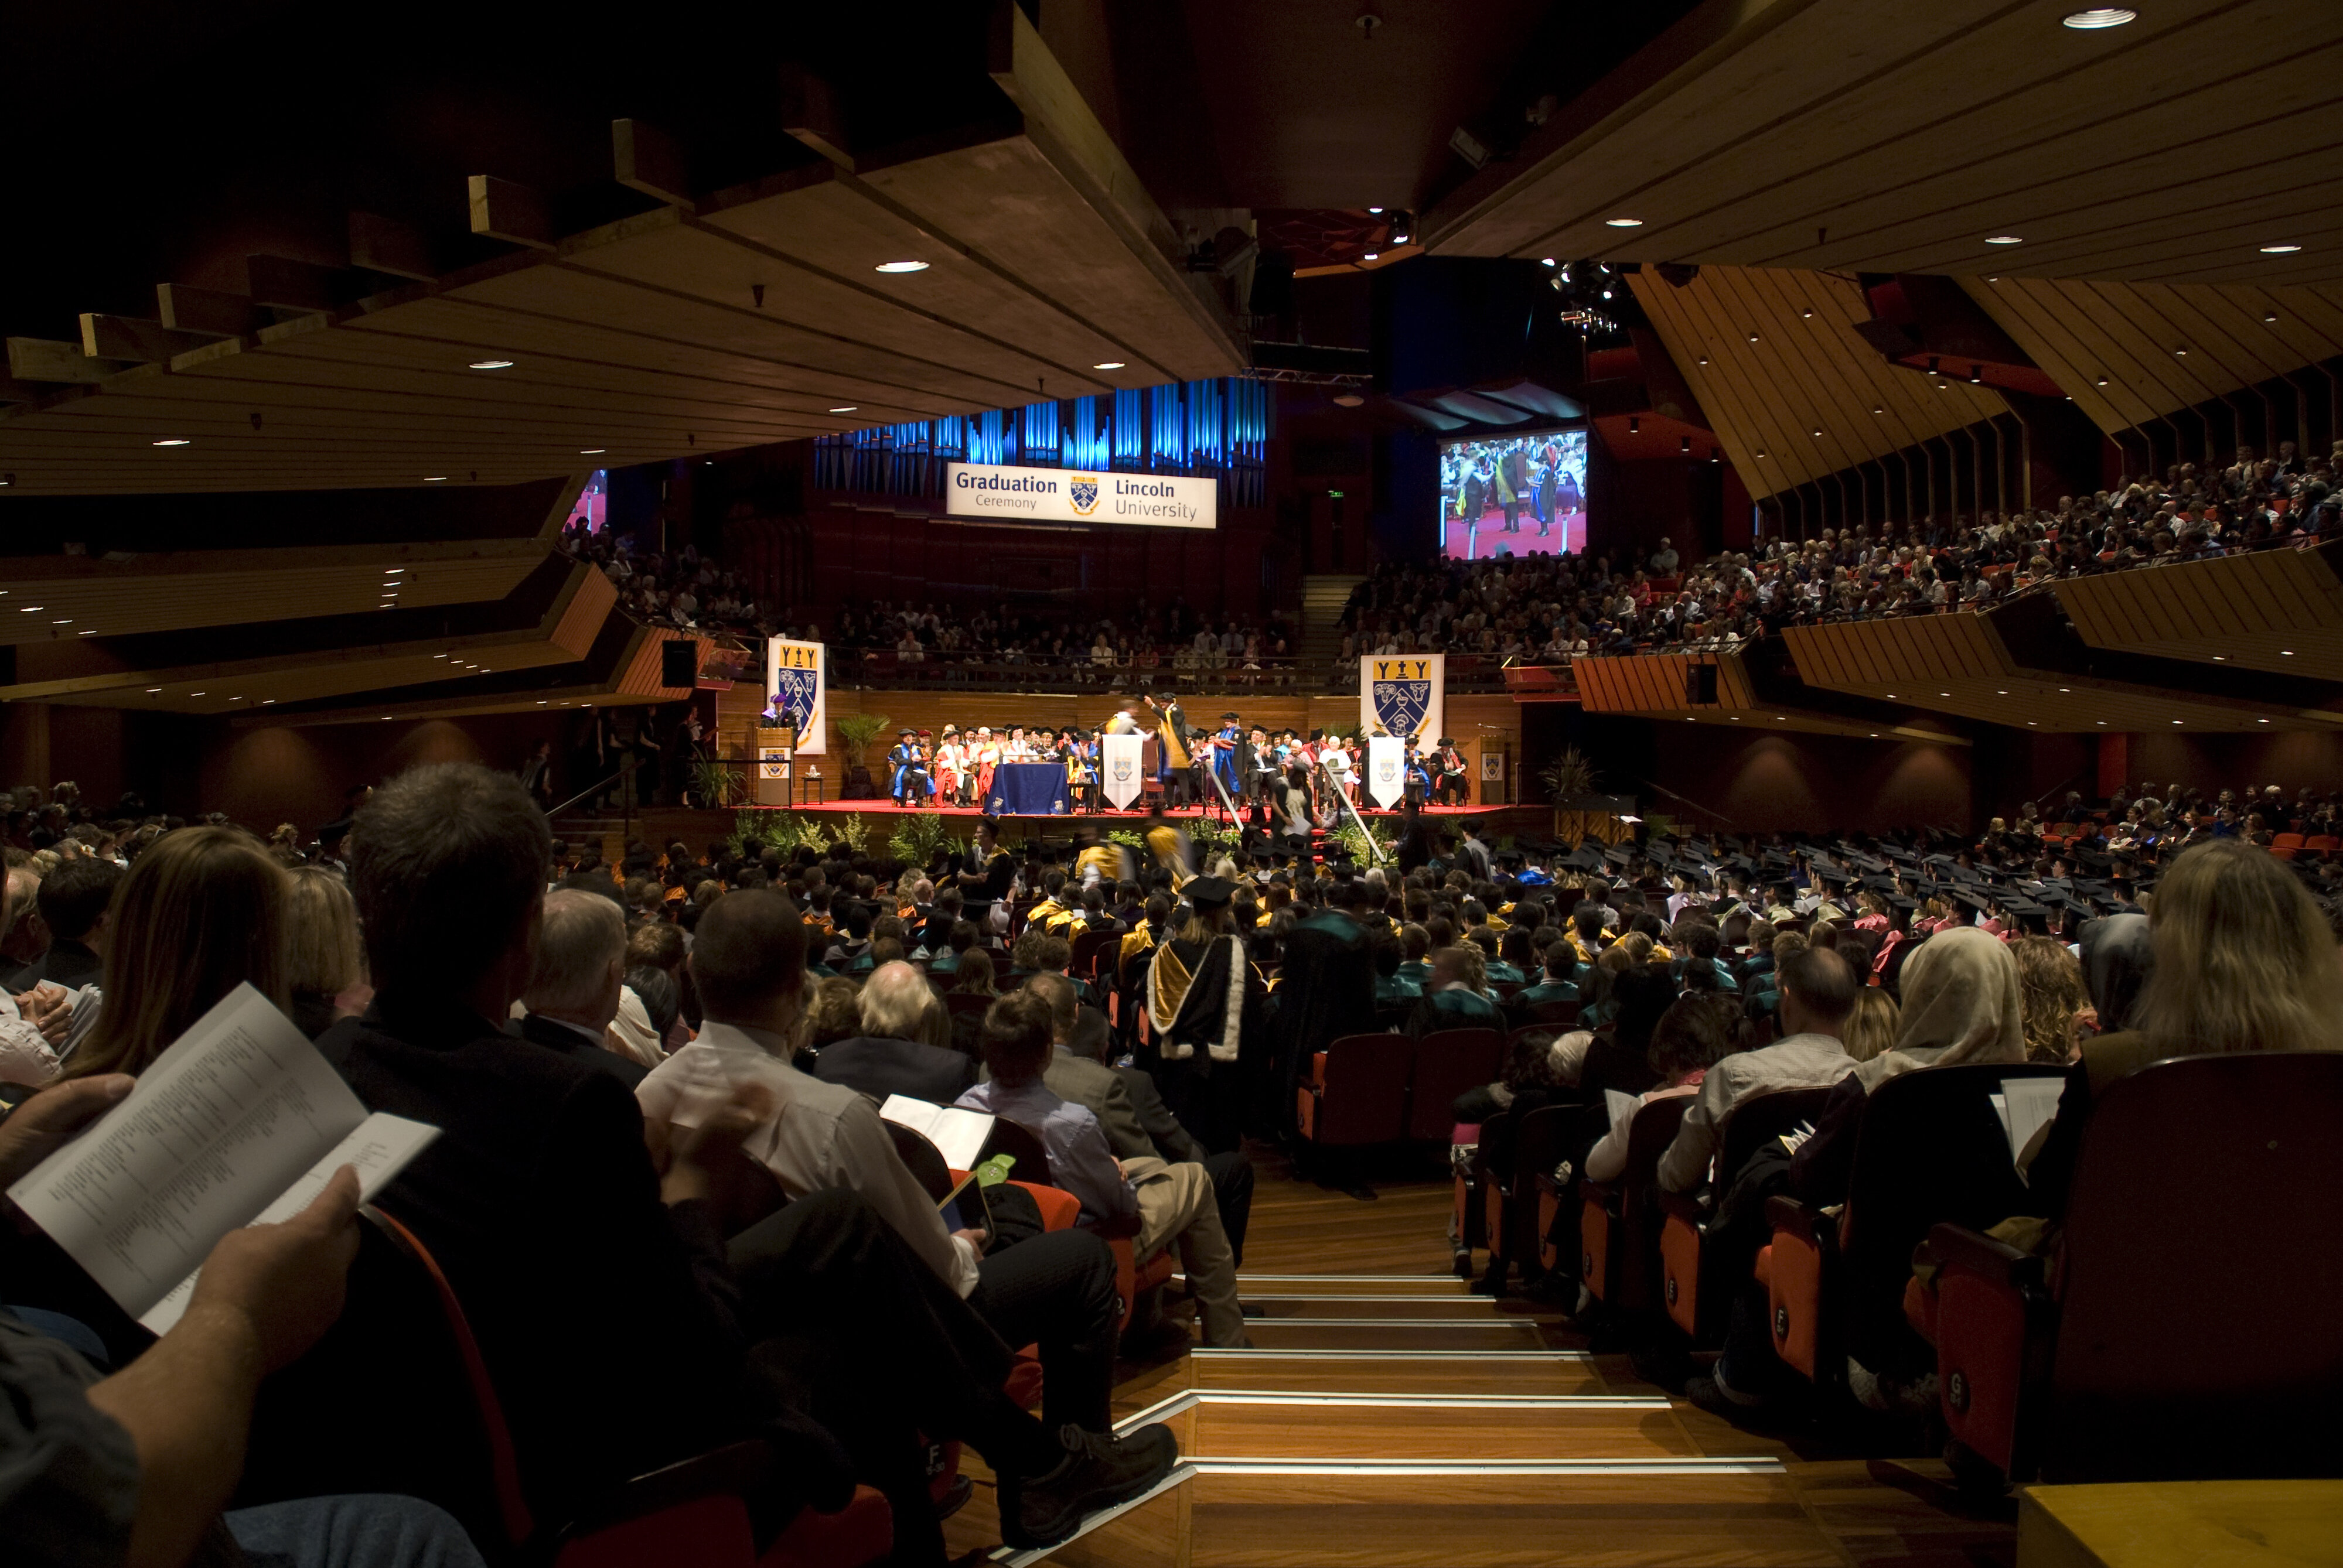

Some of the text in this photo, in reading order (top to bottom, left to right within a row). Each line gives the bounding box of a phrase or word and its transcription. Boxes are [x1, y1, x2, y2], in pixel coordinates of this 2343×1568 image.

[956, 472, 1057, 493] Graduation
[1116, 479, 1174, 497] Lincoln
[976, 494, 1036, 511] Ceremony
[1116, 499, 1197, 522] University
[1669, 1279, 1674, 1293] E
[1778, 1309, 1783, 1324] F
[1952, 1373, 1961, 1395] G
[929, 1444, 940, 1465] F
